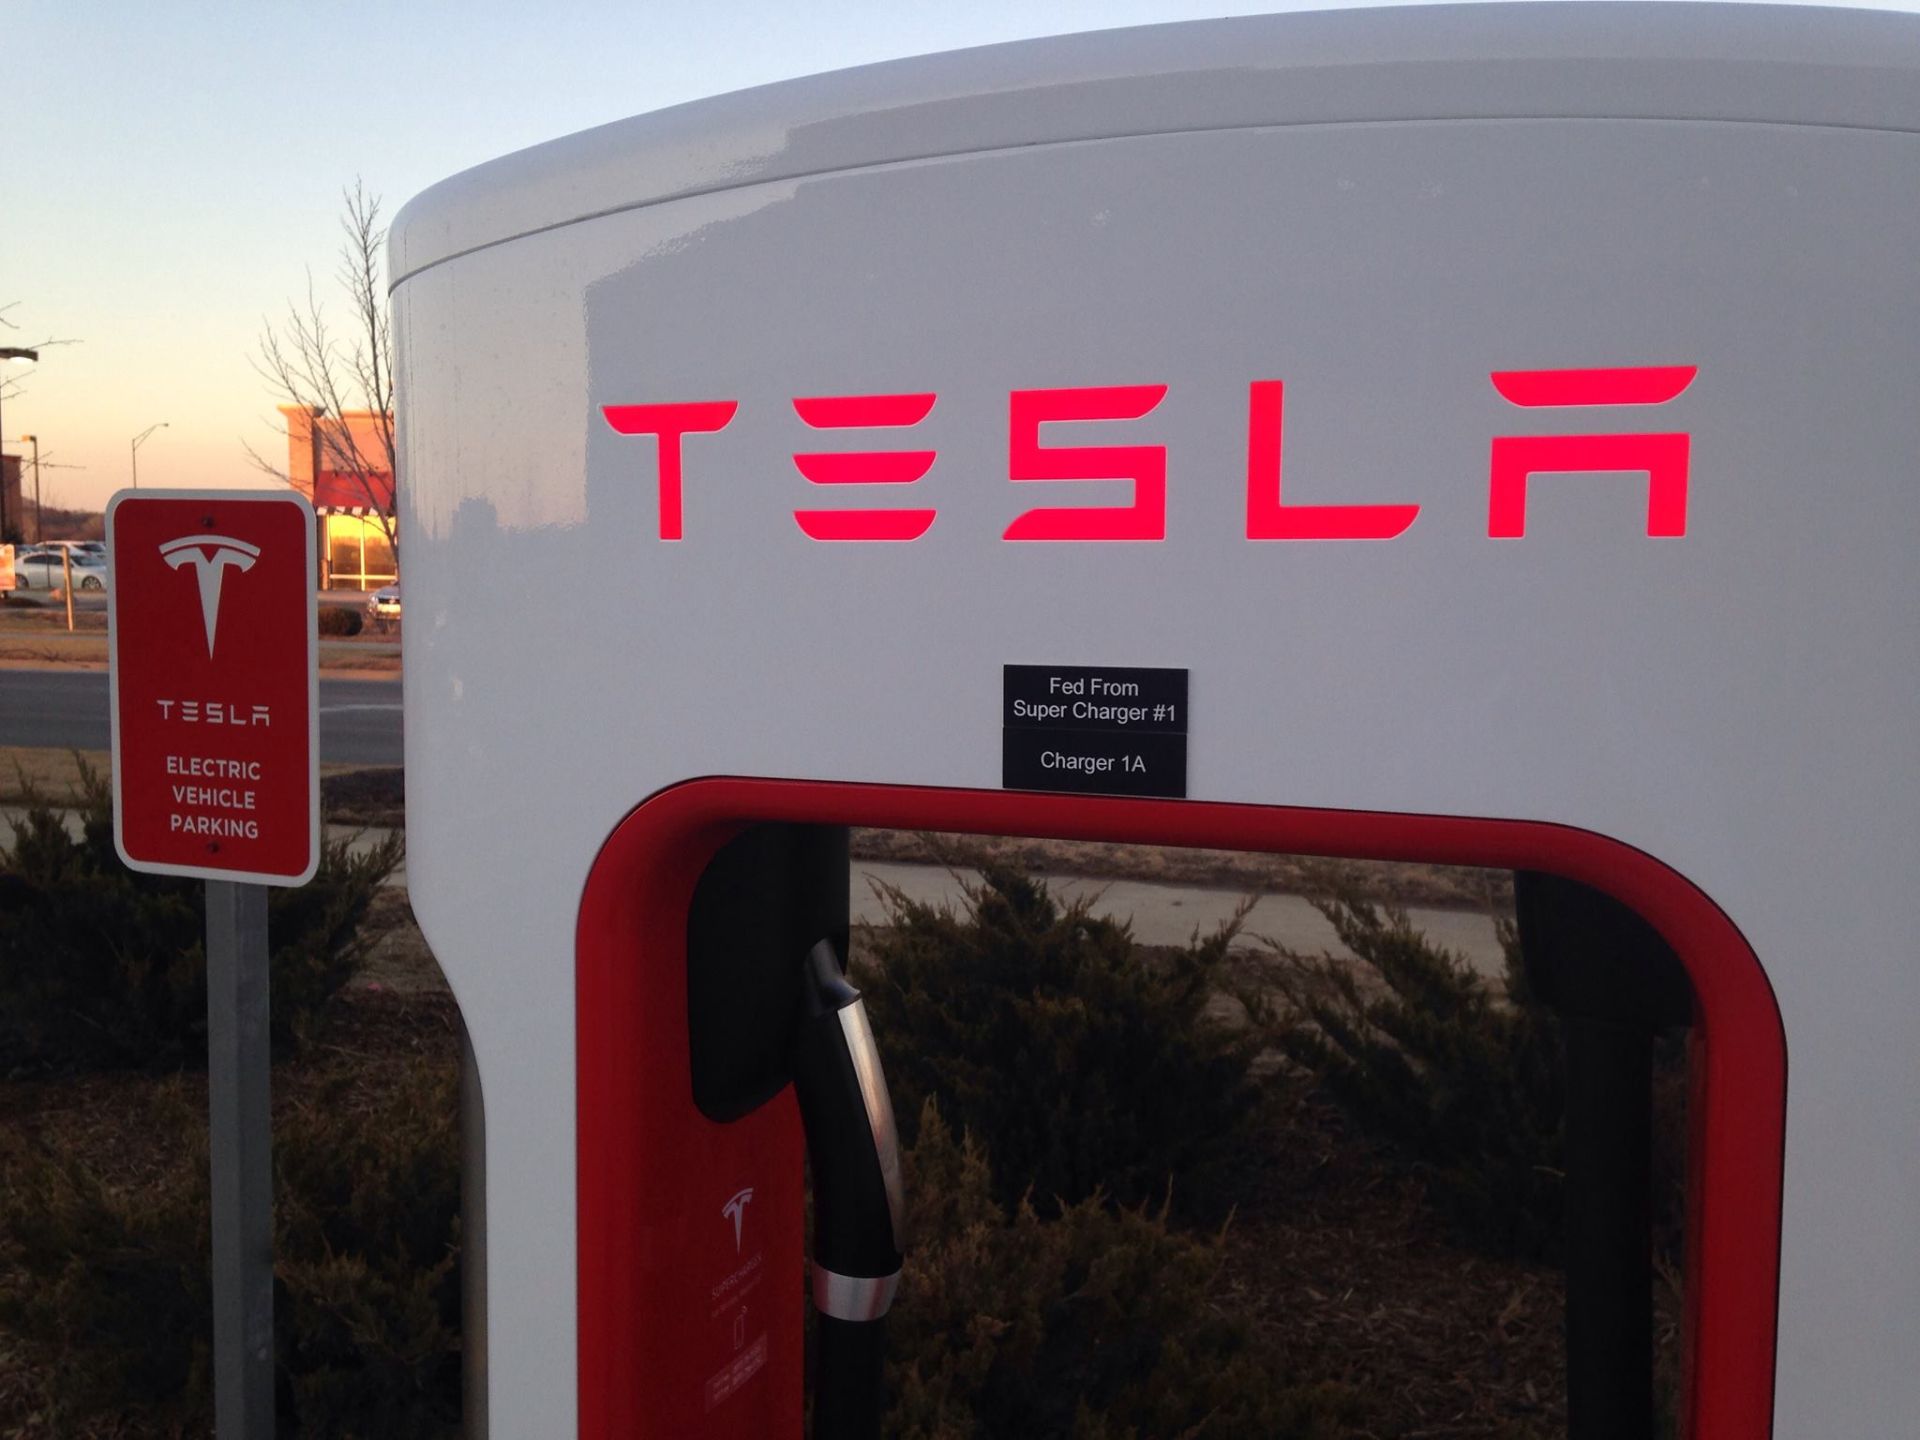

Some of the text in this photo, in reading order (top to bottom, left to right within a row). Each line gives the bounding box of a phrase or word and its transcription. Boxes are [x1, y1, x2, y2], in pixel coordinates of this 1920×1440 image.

[602, 366, 1698, 541] TESLA
[1050, 677, 1139, 697] Fed From
[157, 700, 270, 726] TESLA
[1013, 699, 1175, 725] Super Charger #1
[166, 756, 261, 780] ELECTRIC
[1040, 751, 1146, 775] Charger 1A
[172, 785, 256, 810] VEHICLE
[170, 814, 258, 839] PARKING
